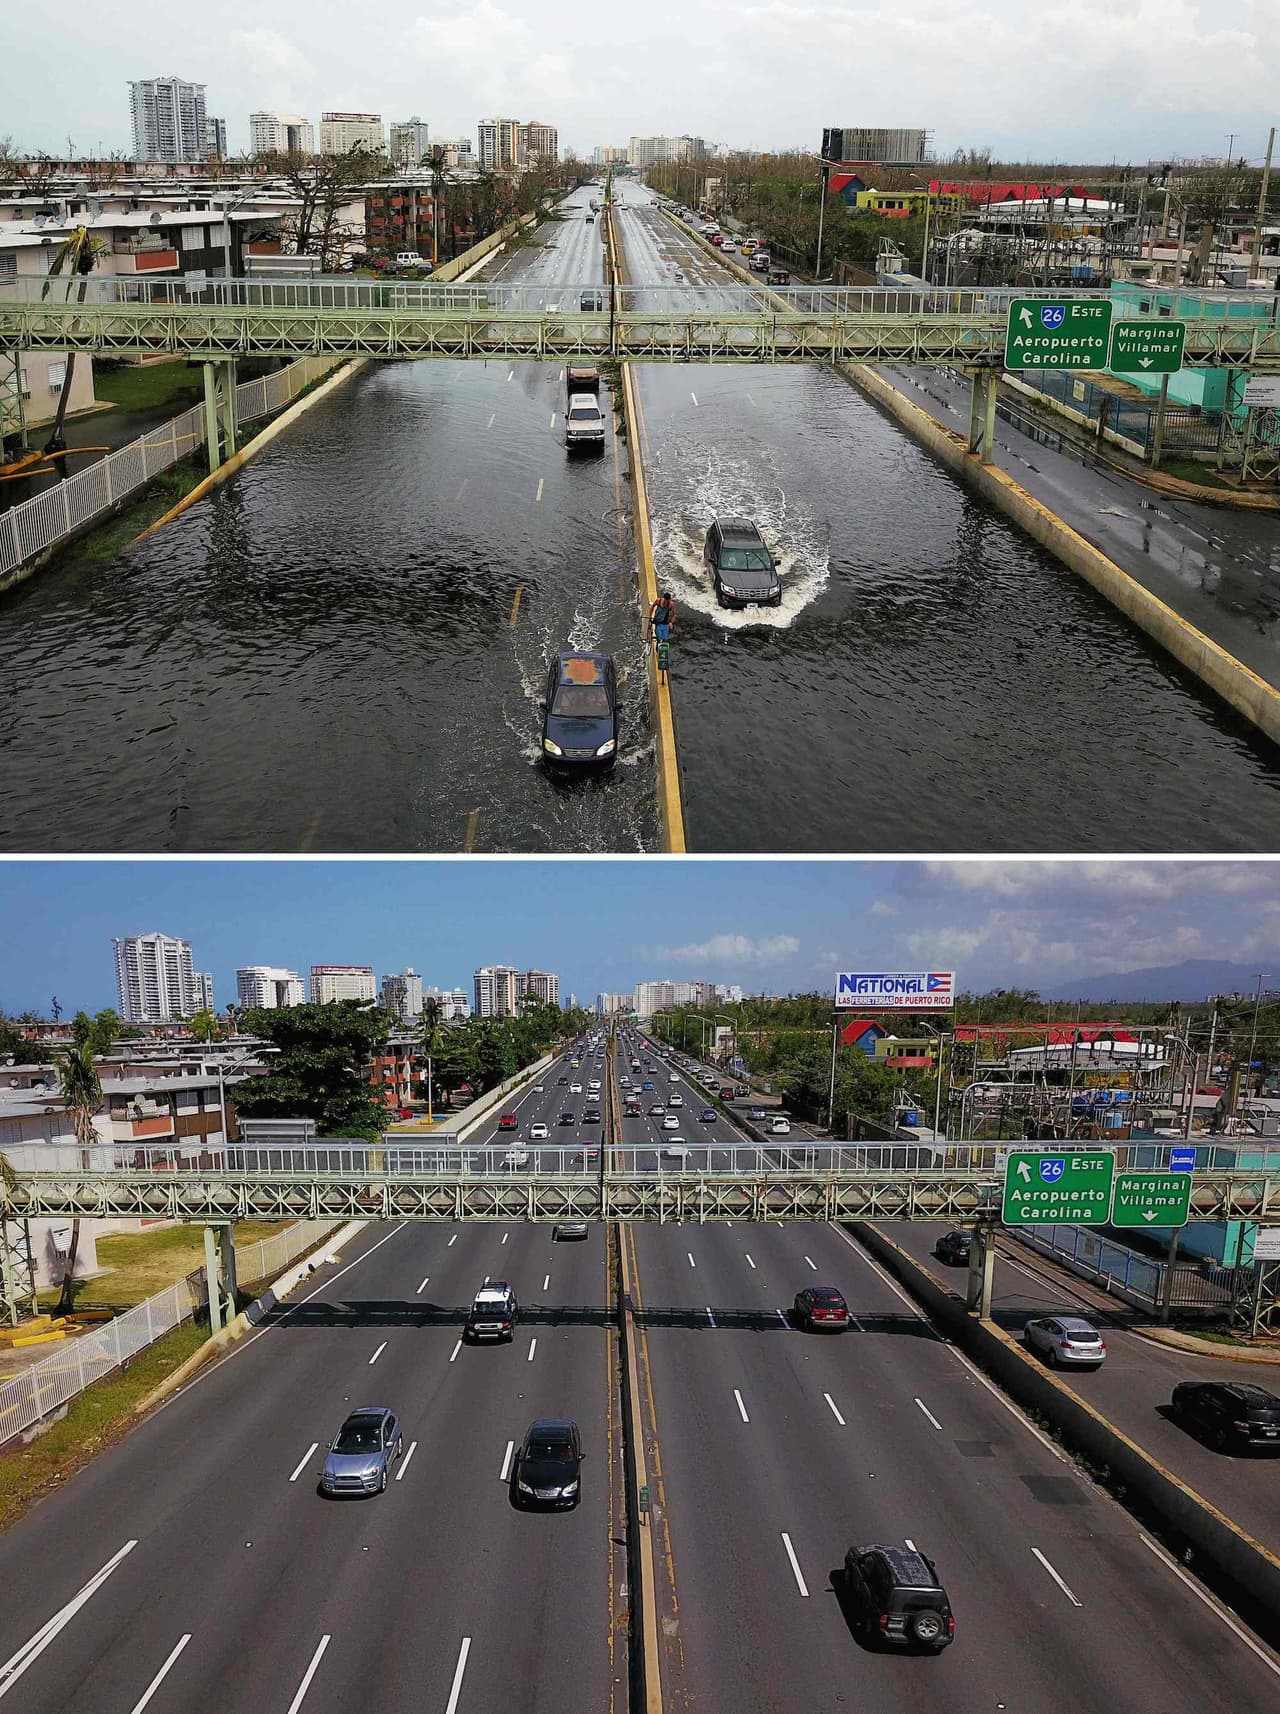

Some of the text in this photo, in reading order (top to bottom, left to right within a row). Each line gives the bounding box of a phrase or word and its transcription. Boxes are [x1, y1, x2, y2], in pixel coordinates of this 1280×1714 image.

[1043, 306, 1103, 322] 26 ESTE
[1119, 328, 1180, 340] Marginal
[1013, 336, 1103, 349] Aeropuerto
[1118, 343, 1178, 353] Villamar
[1022, 352, 1091, 364] Carolina
[839, 974, 925, 994] NATIONAL
[838, 997, 851, 1005] LAS
[895, 997, 904, 1005] DE
[905, 996, 932, 1005] PUERTO
[934, 996, 951, 1005] RICO
[1042, 1158, 1104, 1176] 26 ESTE
[1121, 1180, 1185, 1192] Marginal
[1011, 1190, 1105, 1203] Aeropuerto
[1120, 1195, 1183, 1205] Villamar
[1020, 1207, 1092, 1218] Carolina
